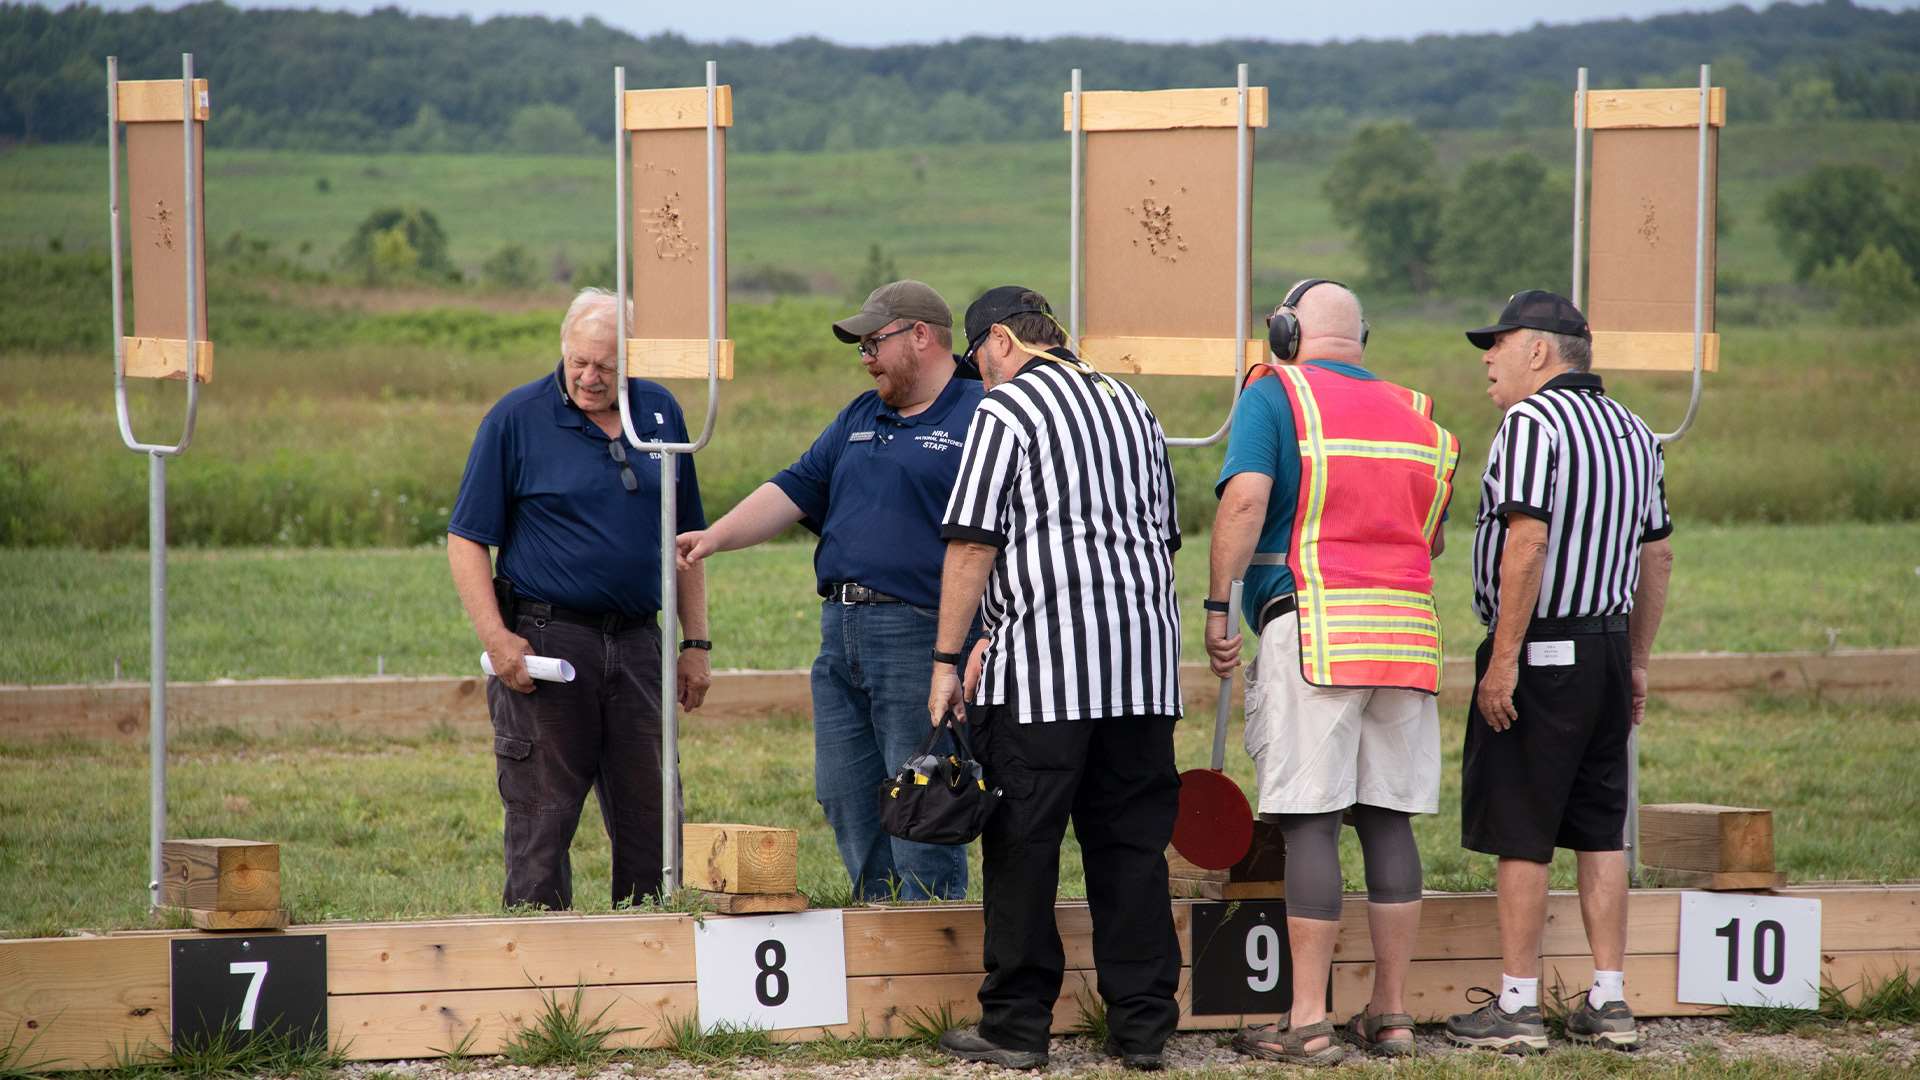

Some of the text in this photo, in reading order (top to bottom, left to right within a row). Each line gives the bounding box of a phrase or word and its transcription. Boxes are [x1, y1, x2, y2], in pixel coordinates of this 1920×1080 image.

[922, 441, 948, 451] STAFF
[932, 430, 949, 438] NRA
[939, 437, 963, 448] MATCHES
[755, 939, 790, 1007] 8
[1245, 924, 1280, 992] 9
[1715, 917, 1786, 985] 10
[229, 961, 268, 1031] 7
